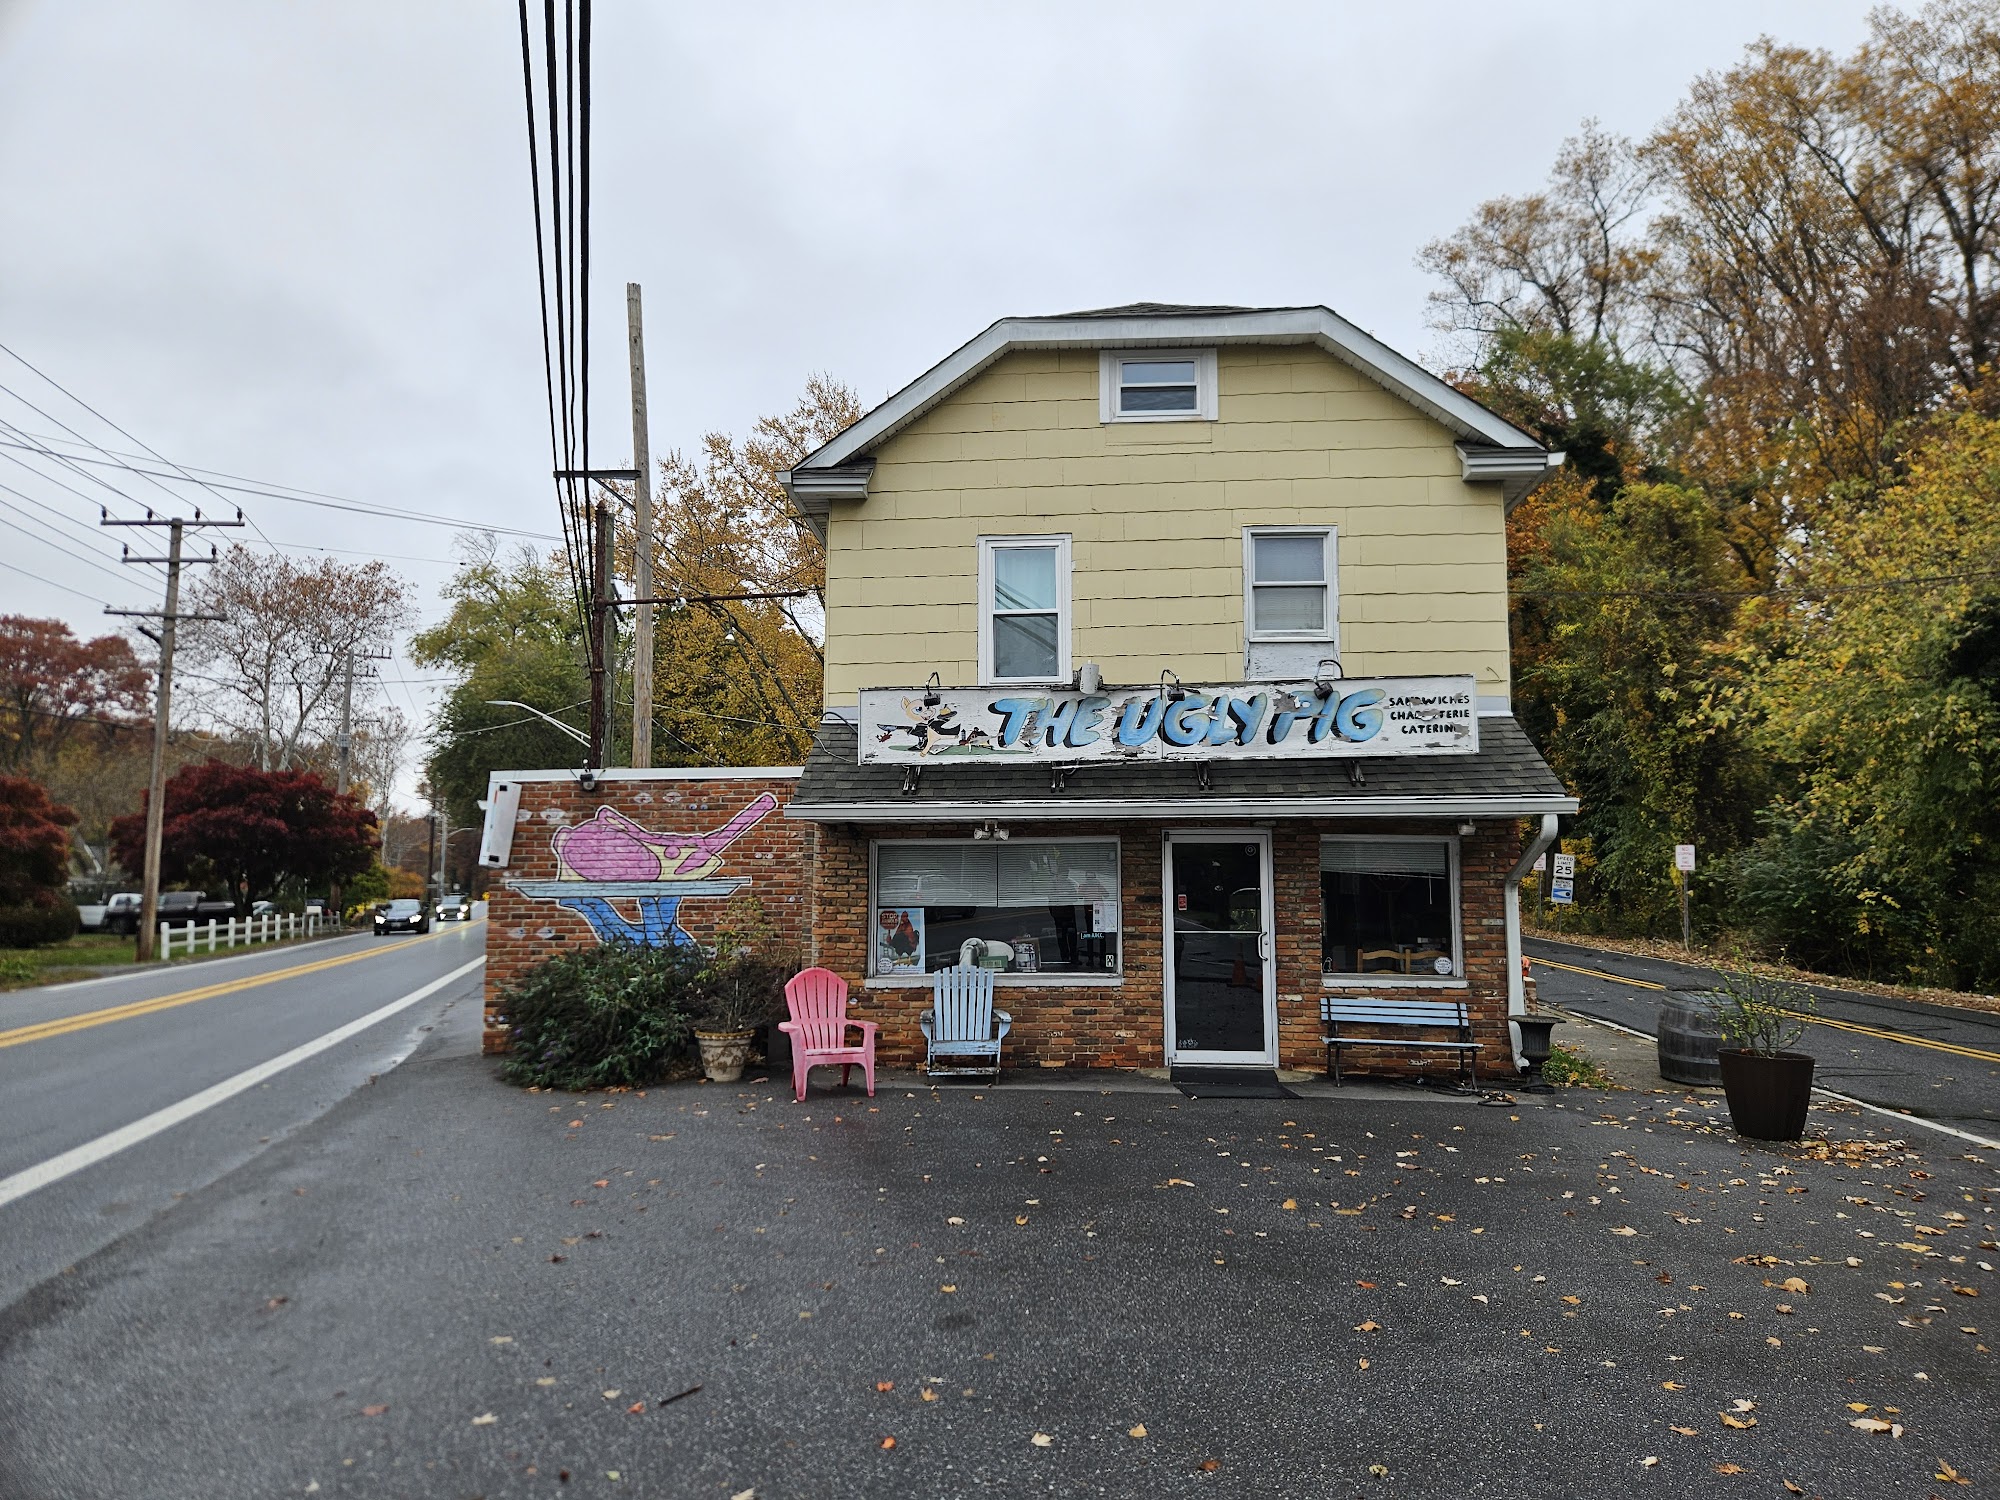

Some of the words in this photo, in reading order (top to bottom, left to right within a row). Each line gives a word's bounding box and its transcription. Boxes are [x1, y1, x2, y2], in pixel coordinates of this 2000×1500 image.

[988, 697, 1111, 748] THE
[1112, 692, 1267, 748] UGLY
[1267, 688, 1386, 744] PIG
[1390, 709, 1470, 720] CHATERIE
[1401, 724, 1457, 734] CATERIN
[1555, 866, 1572, 874] 25
